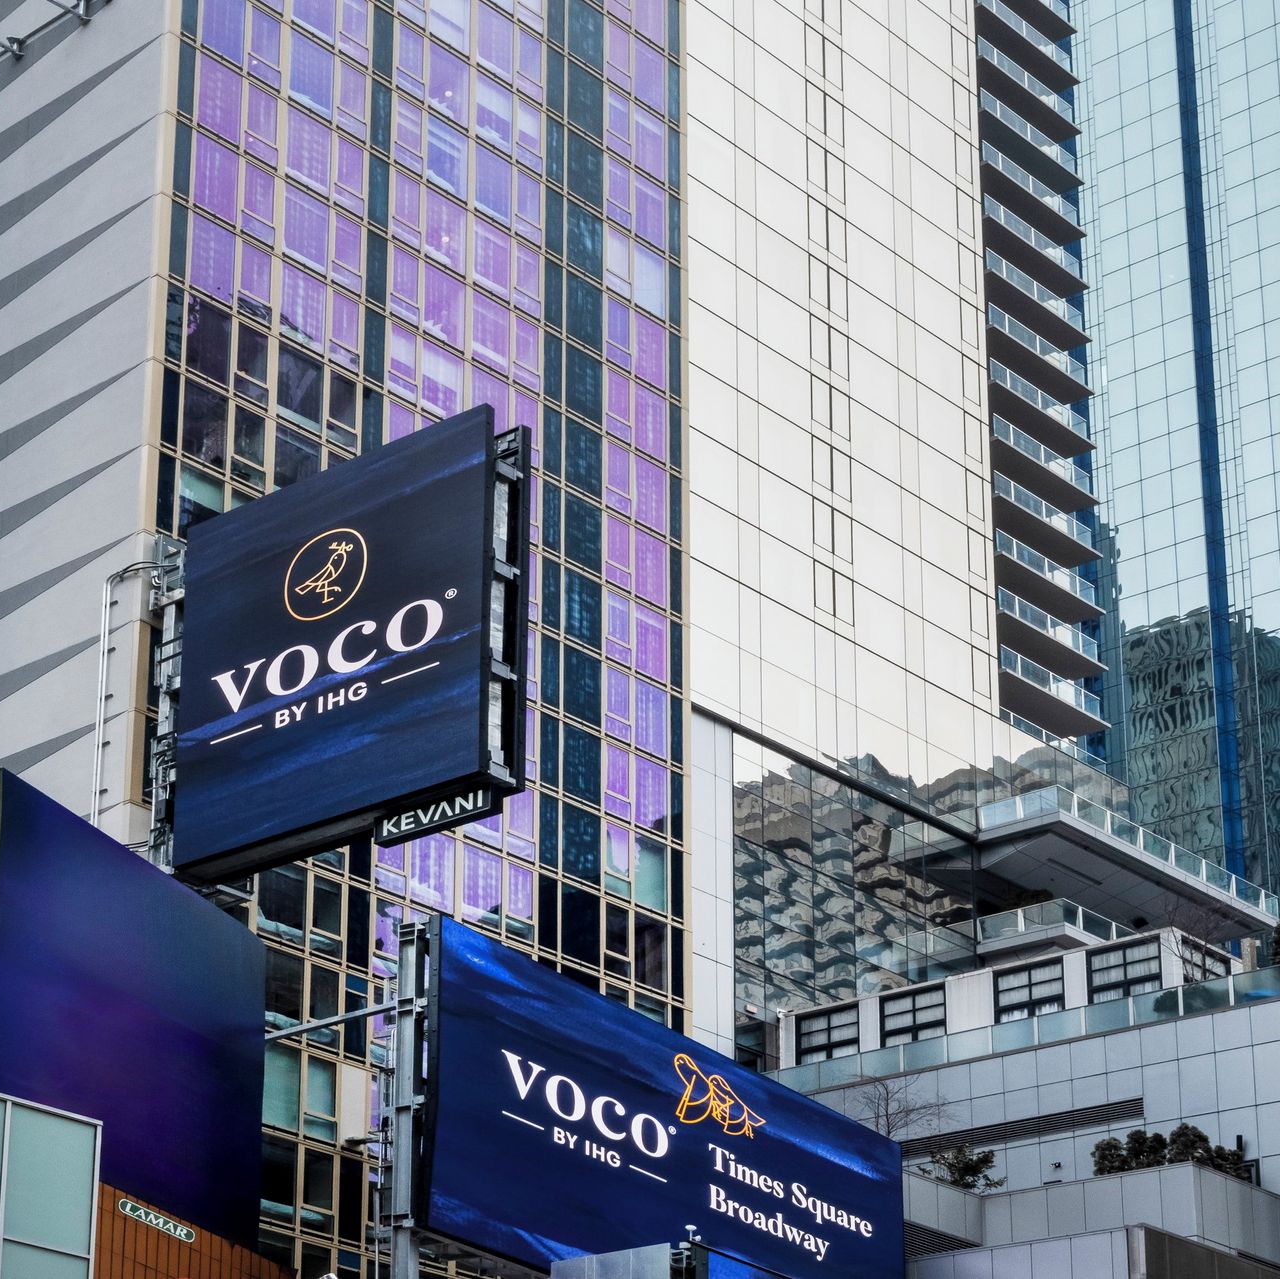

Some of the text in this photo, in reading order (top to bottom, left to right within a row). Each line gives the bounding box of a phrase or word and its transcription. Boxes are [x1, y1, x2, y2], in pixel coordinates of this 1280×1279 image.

[274, 681, 368, 729] BY IHG
[382, 789, 483, 837] KEVANI
[553, 1126, 621, 1168] BY IHG
[708, 1142, 873, 1238] Times Square
[124, 1202, 188, 1239] LAMAR
[709, 1183, 830, 1262] Broadway
